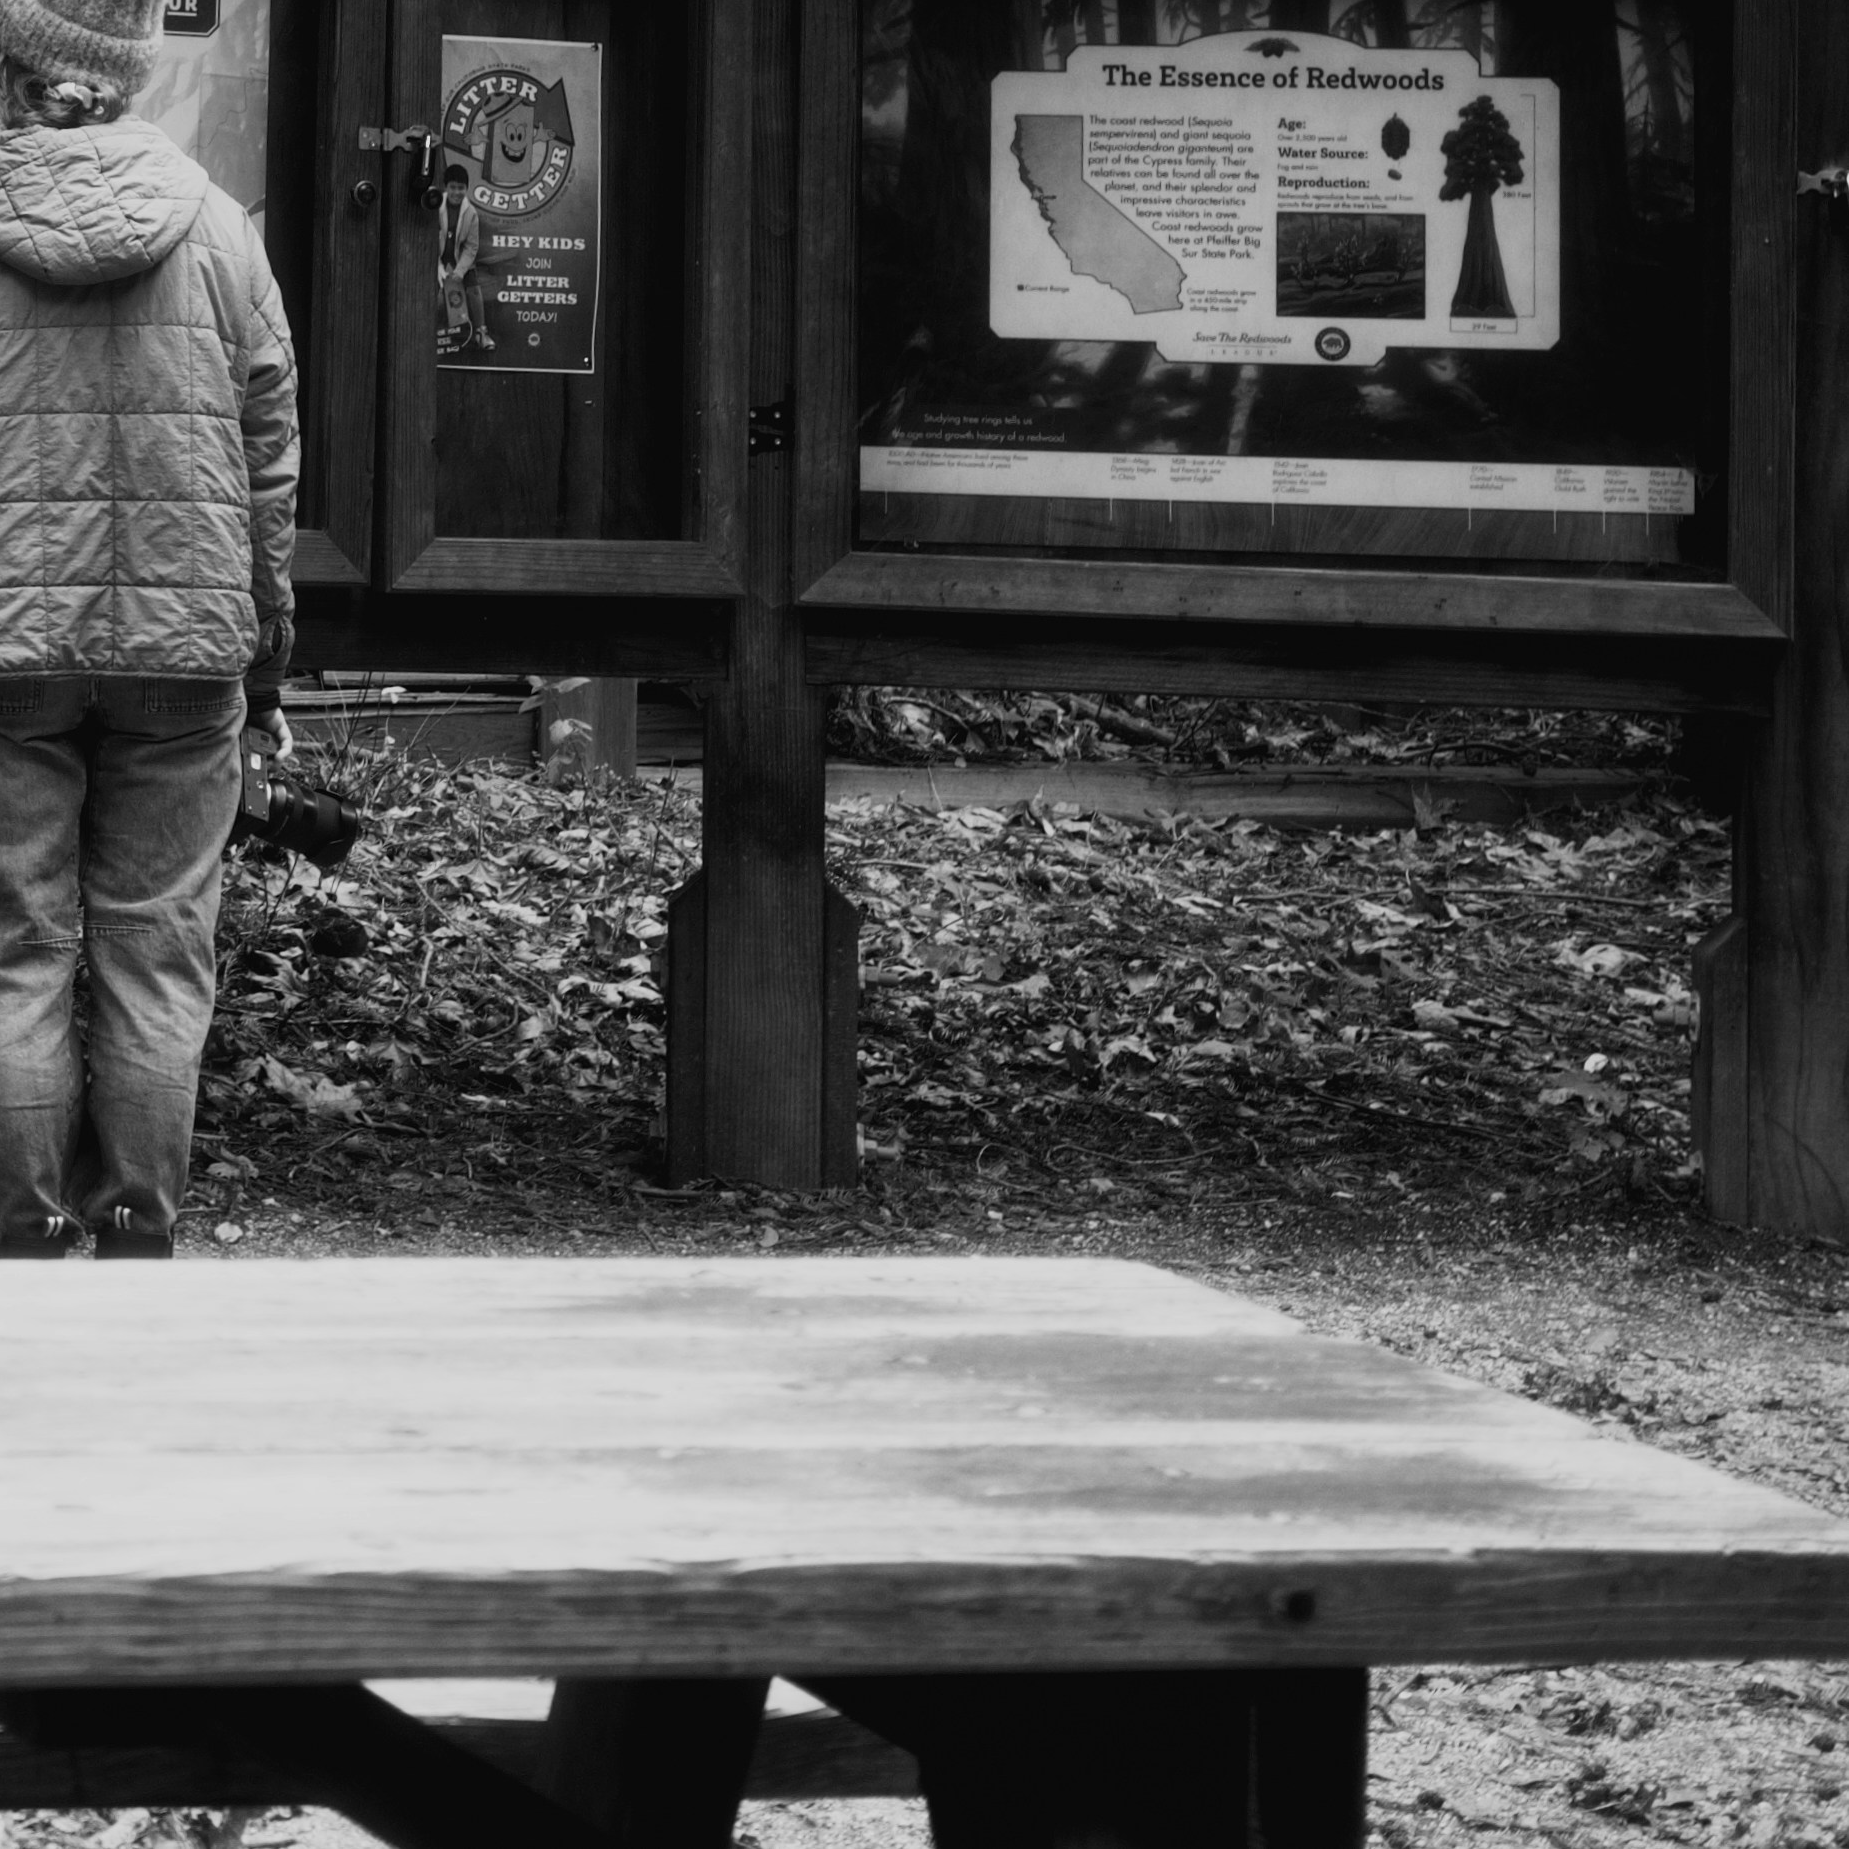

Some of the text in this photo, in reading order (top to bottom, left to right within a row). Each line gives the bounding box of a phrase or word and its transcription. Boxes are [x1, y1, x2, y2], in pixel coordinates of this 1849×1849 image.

[1102, 65, 1444, 90] The Essence of Redwoods
[450, 77, 538, 134] LITTER
[1089, 115, 1233, 128] The coast redwood (Sequoia
[1278, 118, 1306, 132] Age:
[1090, 129, 1251, 142] sempervirens) and giant sequoia
[1089, 142, 1175, 153] (Sequoiadendron
[1278, 147, 1368, 159] Water Source:
[1088, 156, 1109, 168] part
[1111, 155, 1122, 165] of
[1124, 155, 1140, 165] the
[1142, 155, 1183, 169] Cypress
[1222, 156, 1247, 166] Their
[474, 147, 568, 210] GETTER
[1090, 168, 1131, 178] relatives
[1156, 168, 1169, 178] be
[1172, 169, 1201, 179] found
[1204, 169, 1216, 179] all
[1244, 170, 1260, 180] the
[1142, 182, 1162, 191] and
[1165, 182, 1187, 192] their
[1191, 183, 1233, 194] splendor
[1236, 183, 1257, 193] and
[1278, 177, 1370, 189] Reproduction:
[1120, 196, 1246, 207] impressive characteristics
[1136, 208, 1163, 218] leave
[1166, 210, 1200, 218] visitors
[1152, 221, 1263, 235] Coast redwoods grow
[492, 235, 586, 251] HEY KIDS
[1168, 235, 1261, 249] here at Pfeiffer Big
[1182, 248, 1254, 259] Sur State Park.
[526, 257, 552, 269] JOIN
[506, 274, 570, 288] LITTER
[497, 291, 578, 305] GETTERS
[516, 311, 558, 323] TODAY!
[924, 414, 961, 425] Studying
[963, 416, 979, 424] tree
[981, 416, 1003, 427] rings
[1004, 415, 1021, 425] tells
